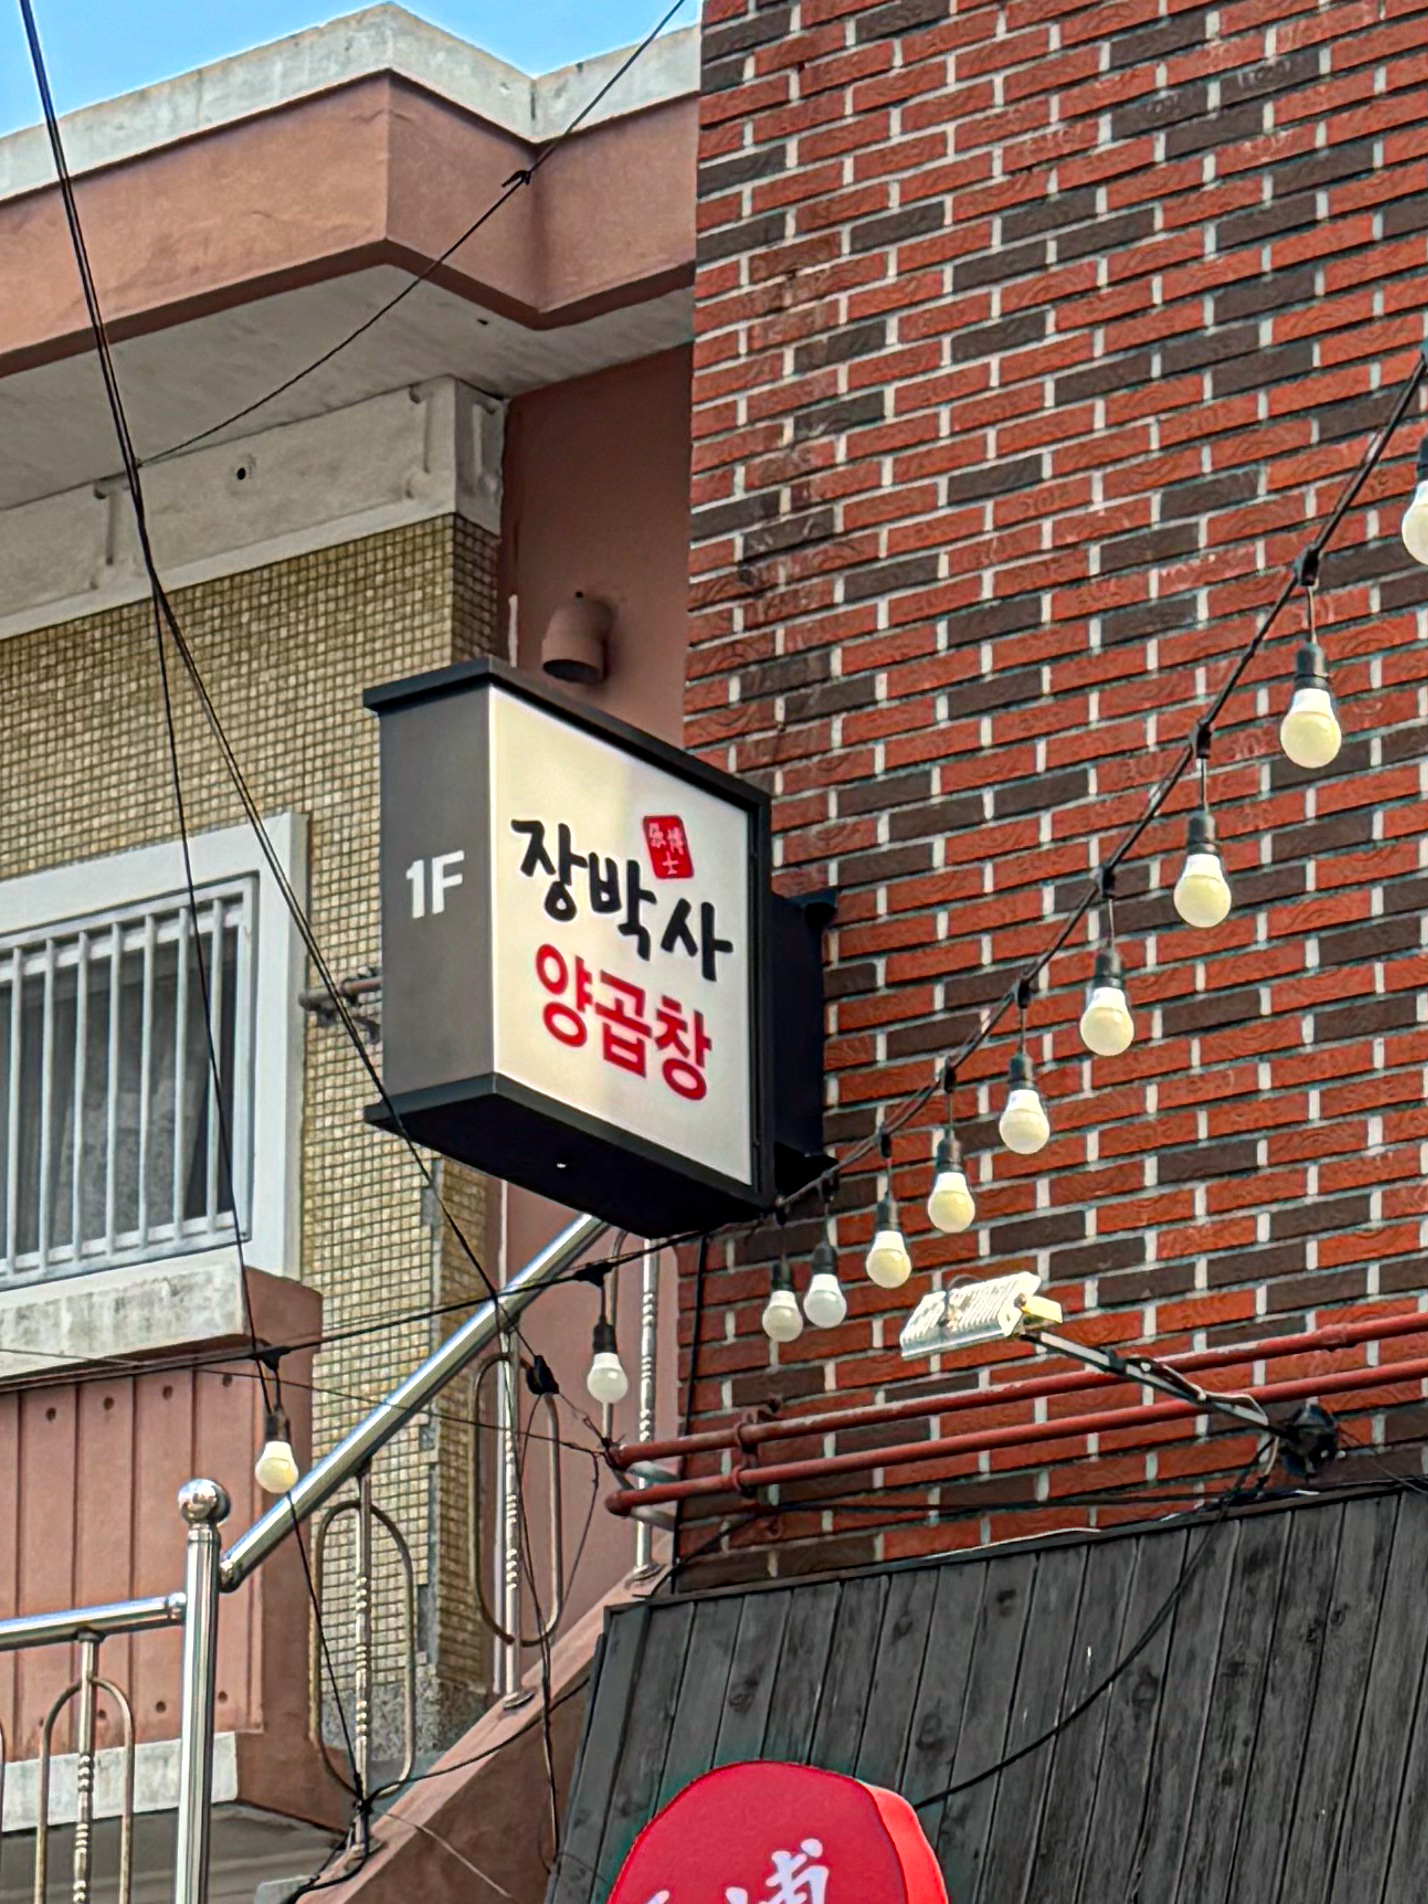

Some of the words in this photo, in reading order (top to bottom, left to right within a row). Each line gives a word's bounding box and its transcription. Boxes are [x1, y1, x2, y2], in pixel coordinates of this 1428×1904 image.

[405, 850, 464, 918] 1F
[511, 819, 734, 982] 장박사
[535, 943, 709, 1100] 양곱창
